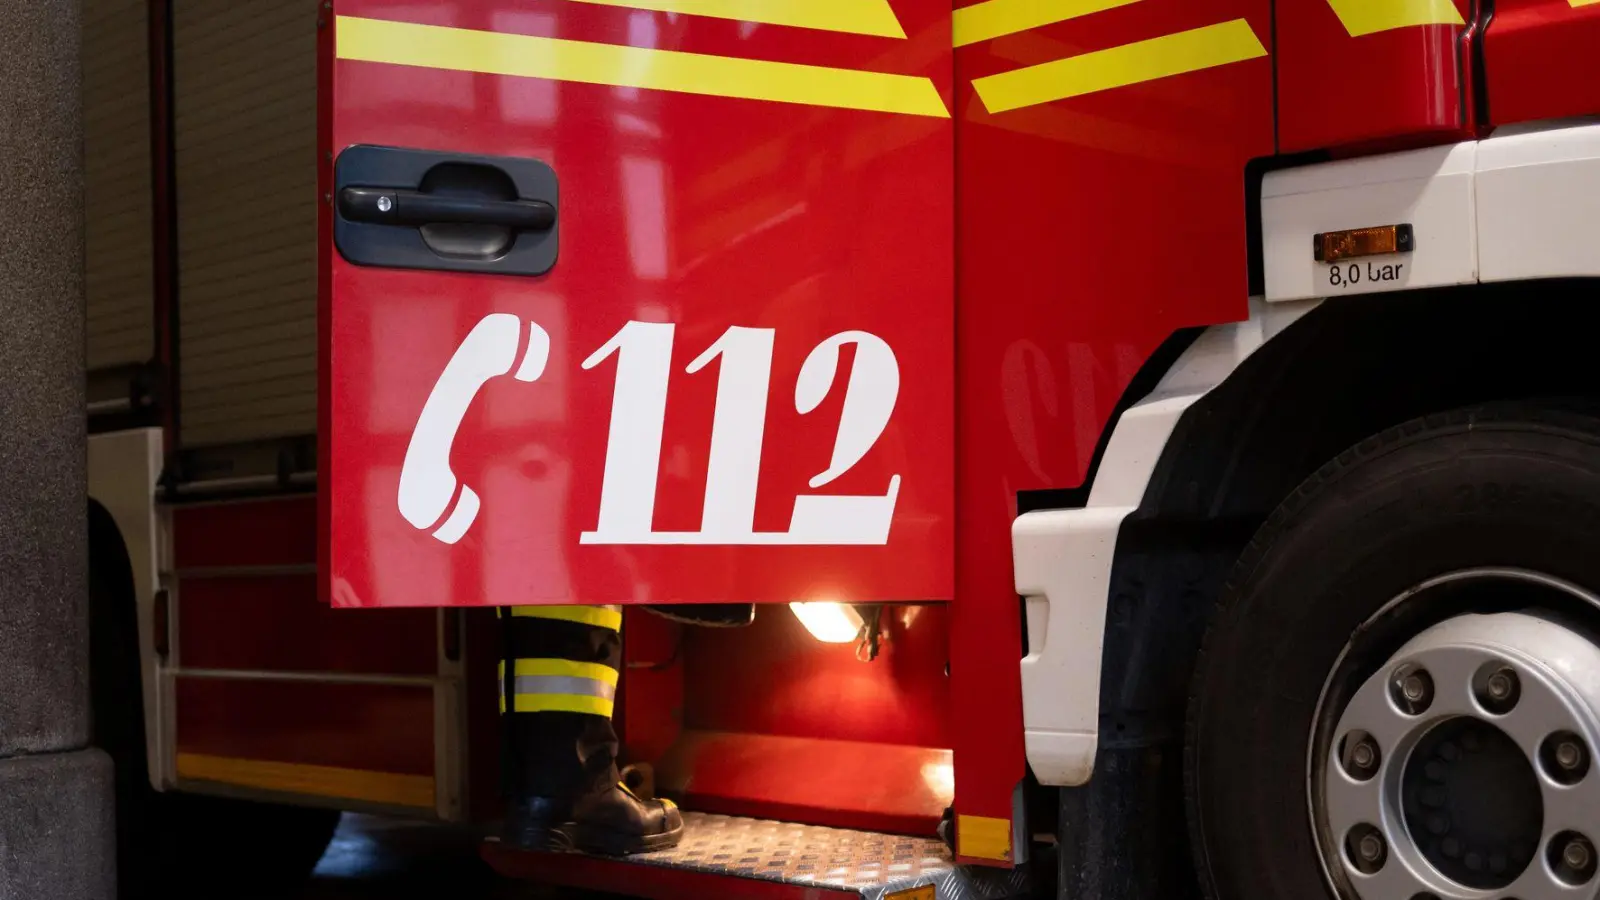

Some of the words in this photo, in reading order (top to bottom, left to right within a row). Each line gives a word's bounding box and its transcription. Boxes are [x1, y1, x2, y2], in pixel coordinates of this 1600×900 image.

[1329, 263, 1361, 288] 8,0
[1367, 262, 1403, 282] bar
[579, 320, 901, 545] 112
